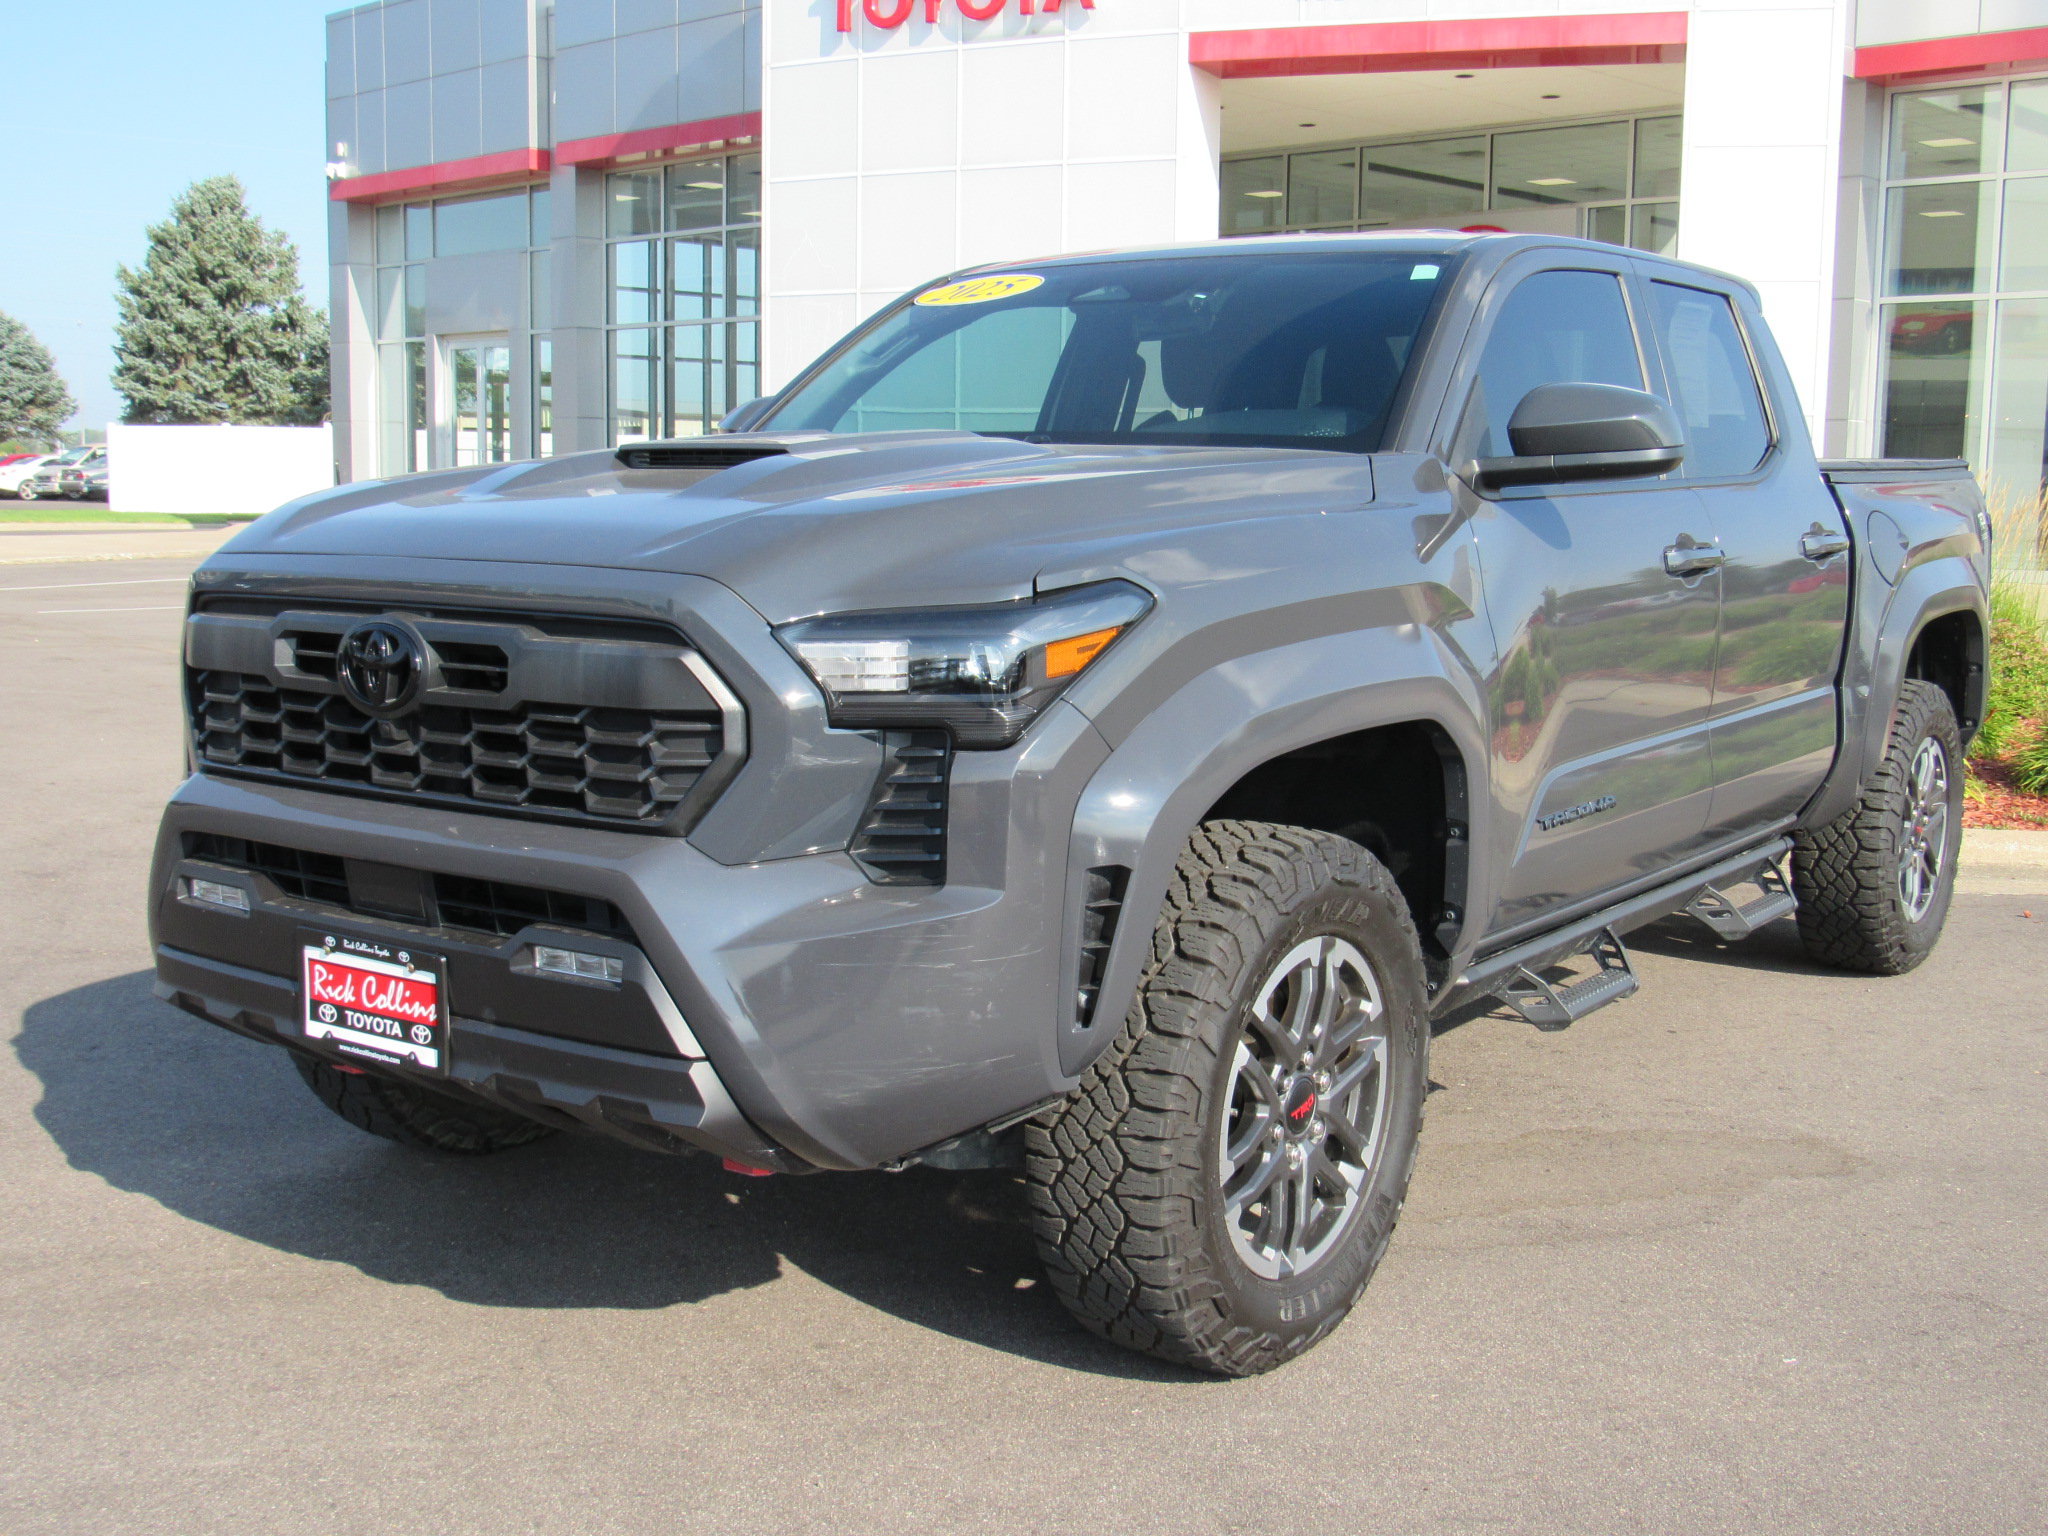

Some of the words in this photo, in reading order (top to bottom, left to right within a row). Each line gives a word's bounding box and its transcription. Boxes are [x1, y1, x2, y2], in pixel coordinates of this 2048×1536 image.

[926, 277, 1030, 303] 2025
[1536, 795, 1617, 831] TACOMA
[314, 964, 356, 1003] Rick
[362, 975, 437, 1021] Collins
[345, 1010, 403, 1037] TOYOTA
[1291, 1093, 1315, 1120] TRD
